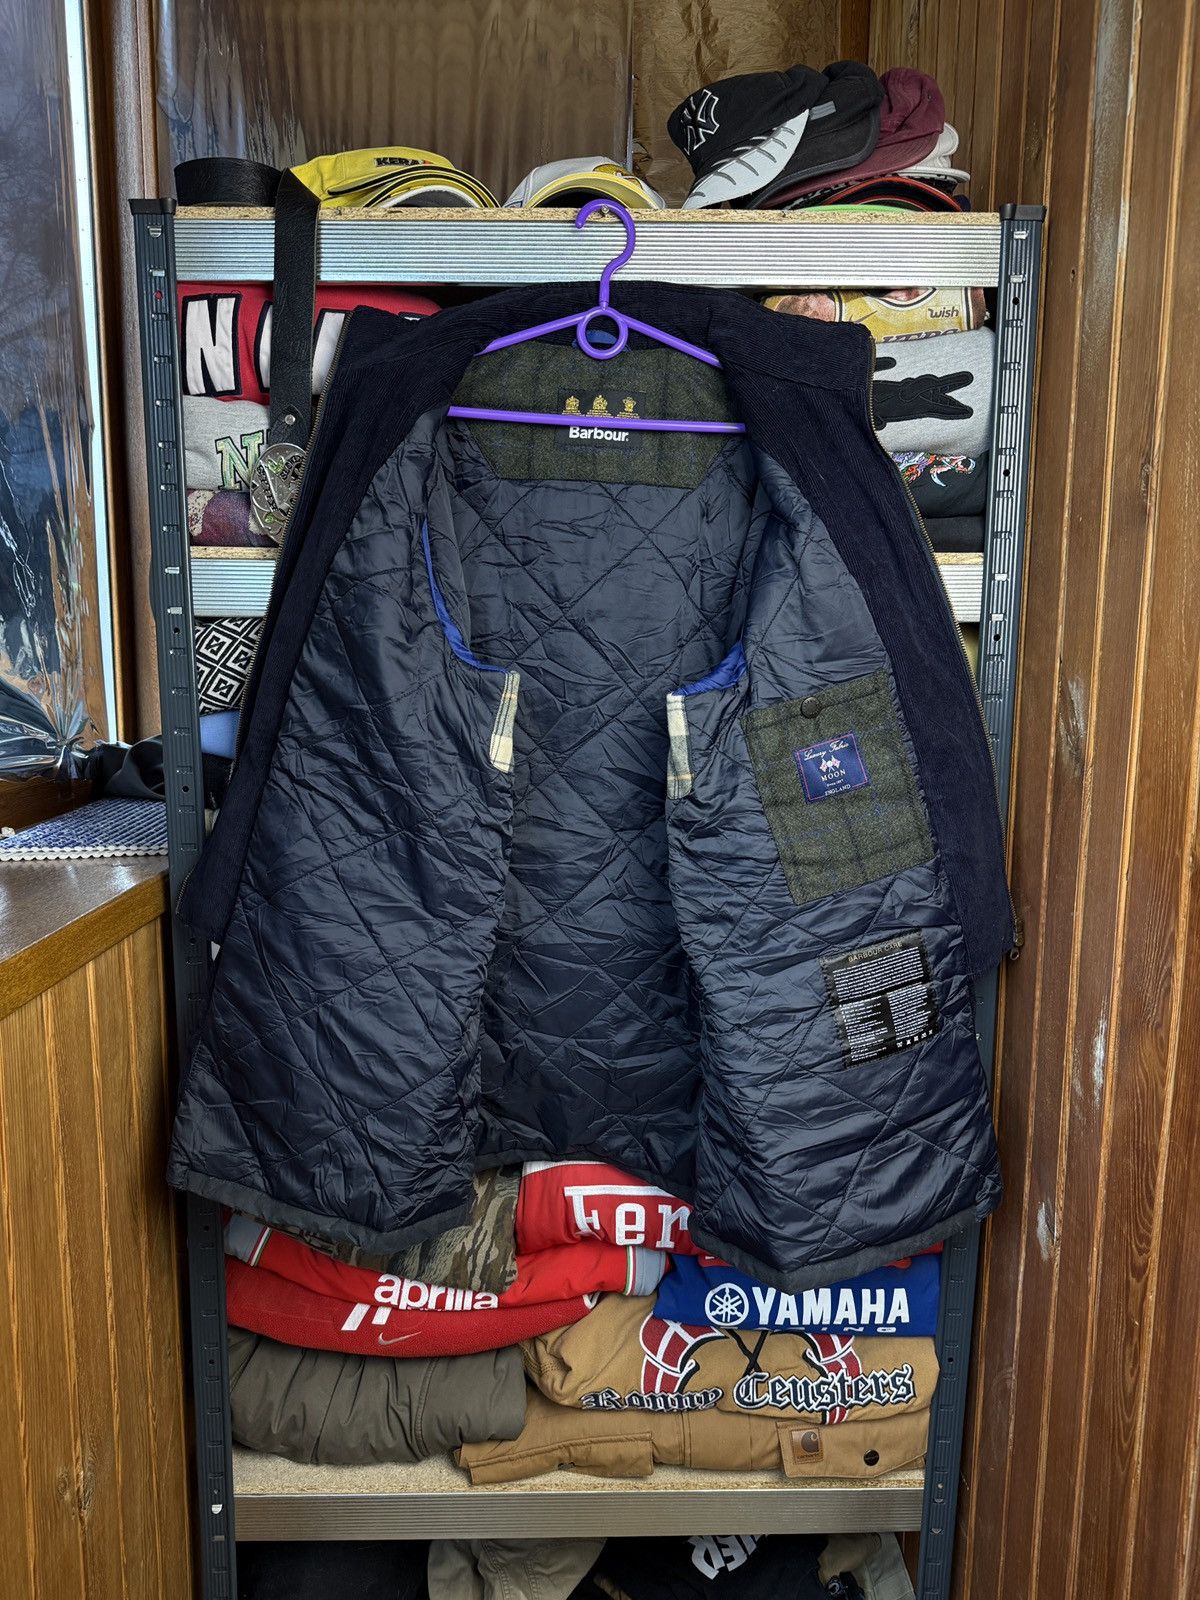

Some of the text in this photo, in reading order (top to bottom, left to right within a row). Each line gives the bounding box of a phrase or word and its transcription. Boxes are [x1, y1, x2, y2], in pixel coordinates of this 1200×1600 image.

[927, 305, 959, 319] wish
[821, 769, 846, 781] MOON
[825, 784, 851, 796] ENGLAND
[751, 1286, 910, 1326] YAMAHA
